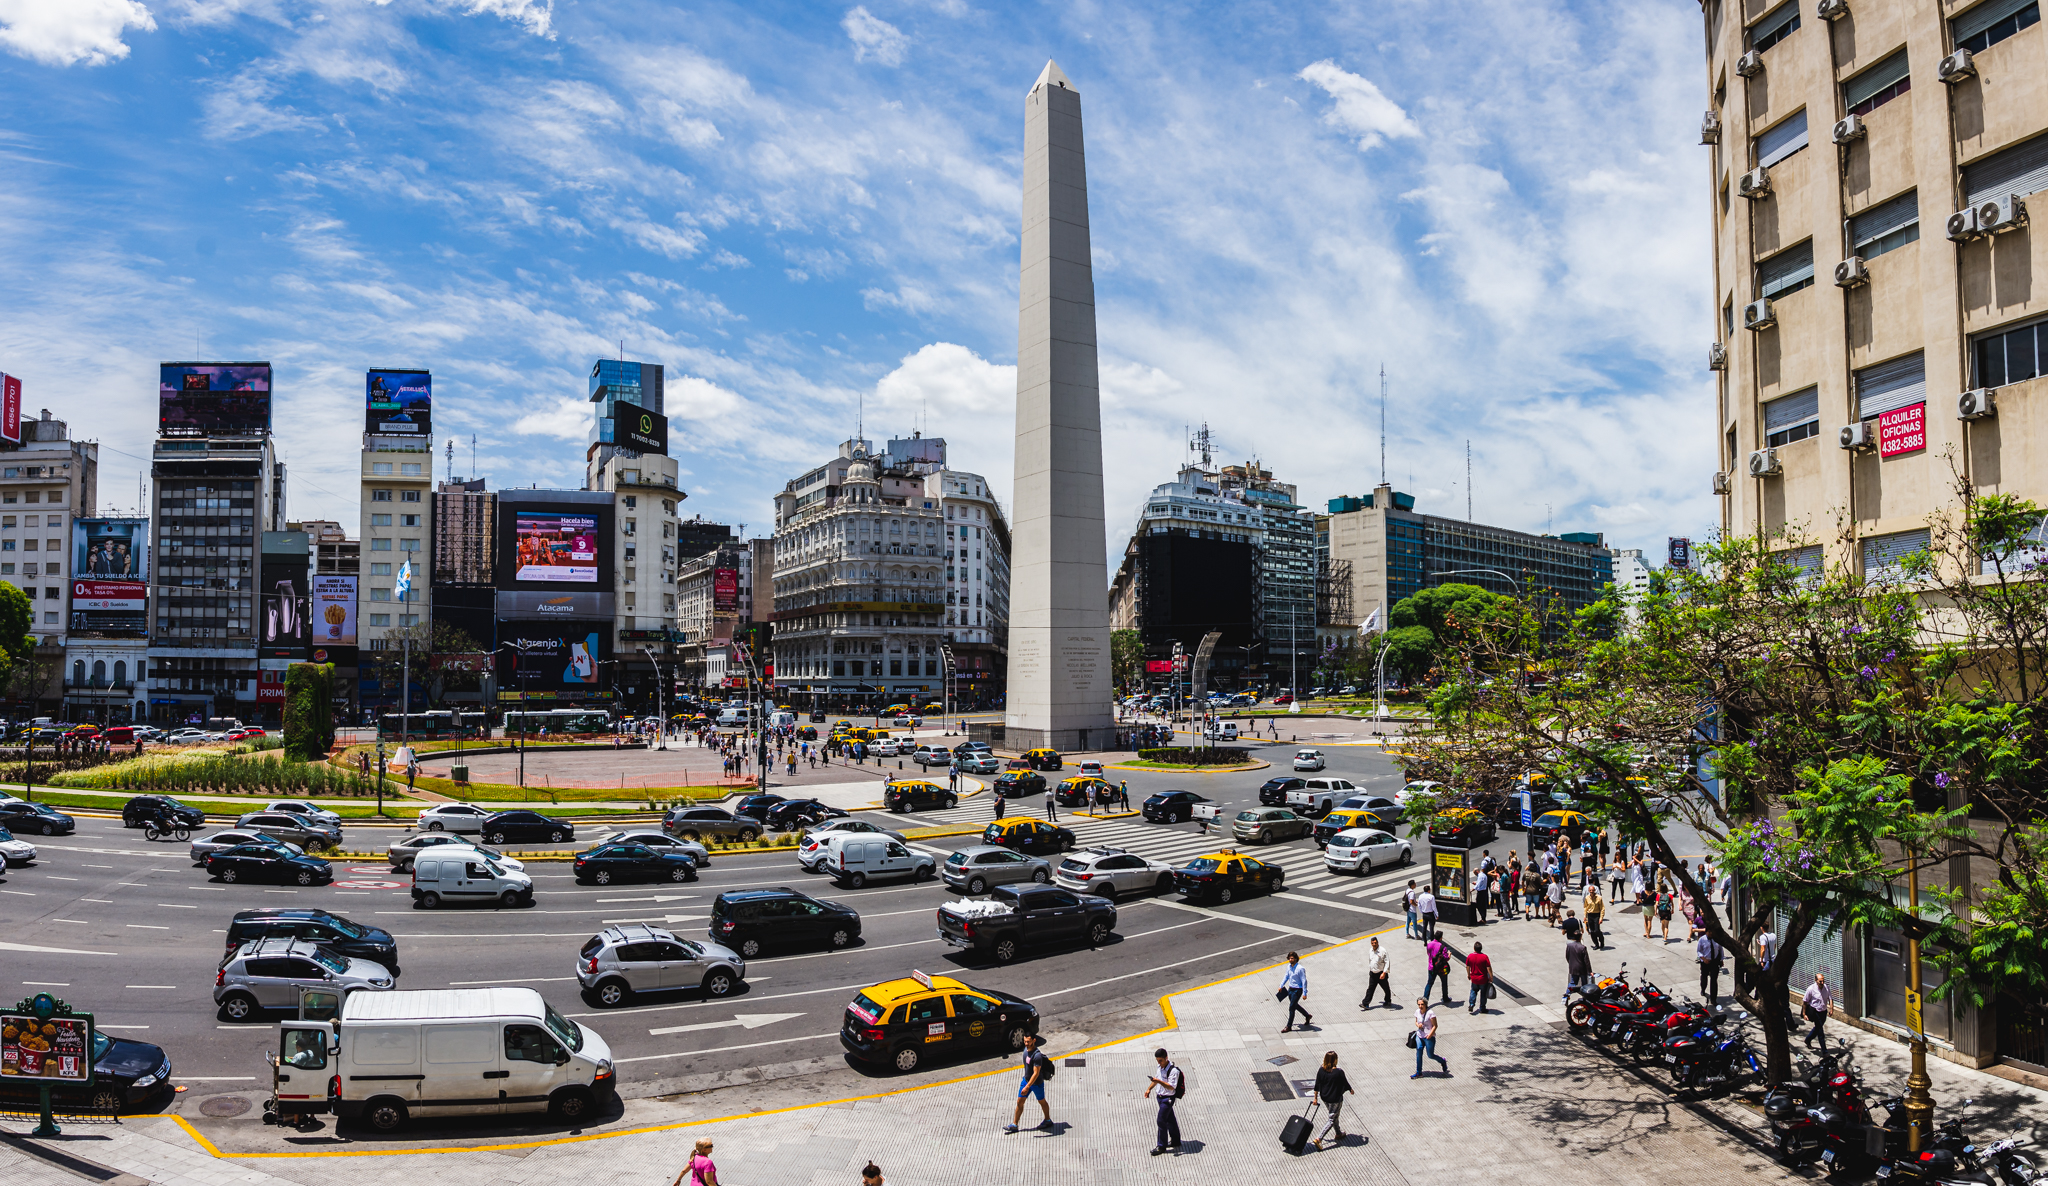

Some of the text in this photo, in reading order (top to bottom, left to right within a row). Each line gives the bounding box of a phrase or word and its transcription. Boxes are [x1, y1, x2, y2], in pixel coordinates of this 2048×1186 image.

[394, 385, 432, 399] METALLICA
[1881, 408, 1922, 427] ALQUILER
[1882, 420, 1920, 438] OFICINAS
[1882, 434, 1923, 453] 4382-5885
[579, 541, 586, 549] 9
[76, 584, 91, 595] 0%
